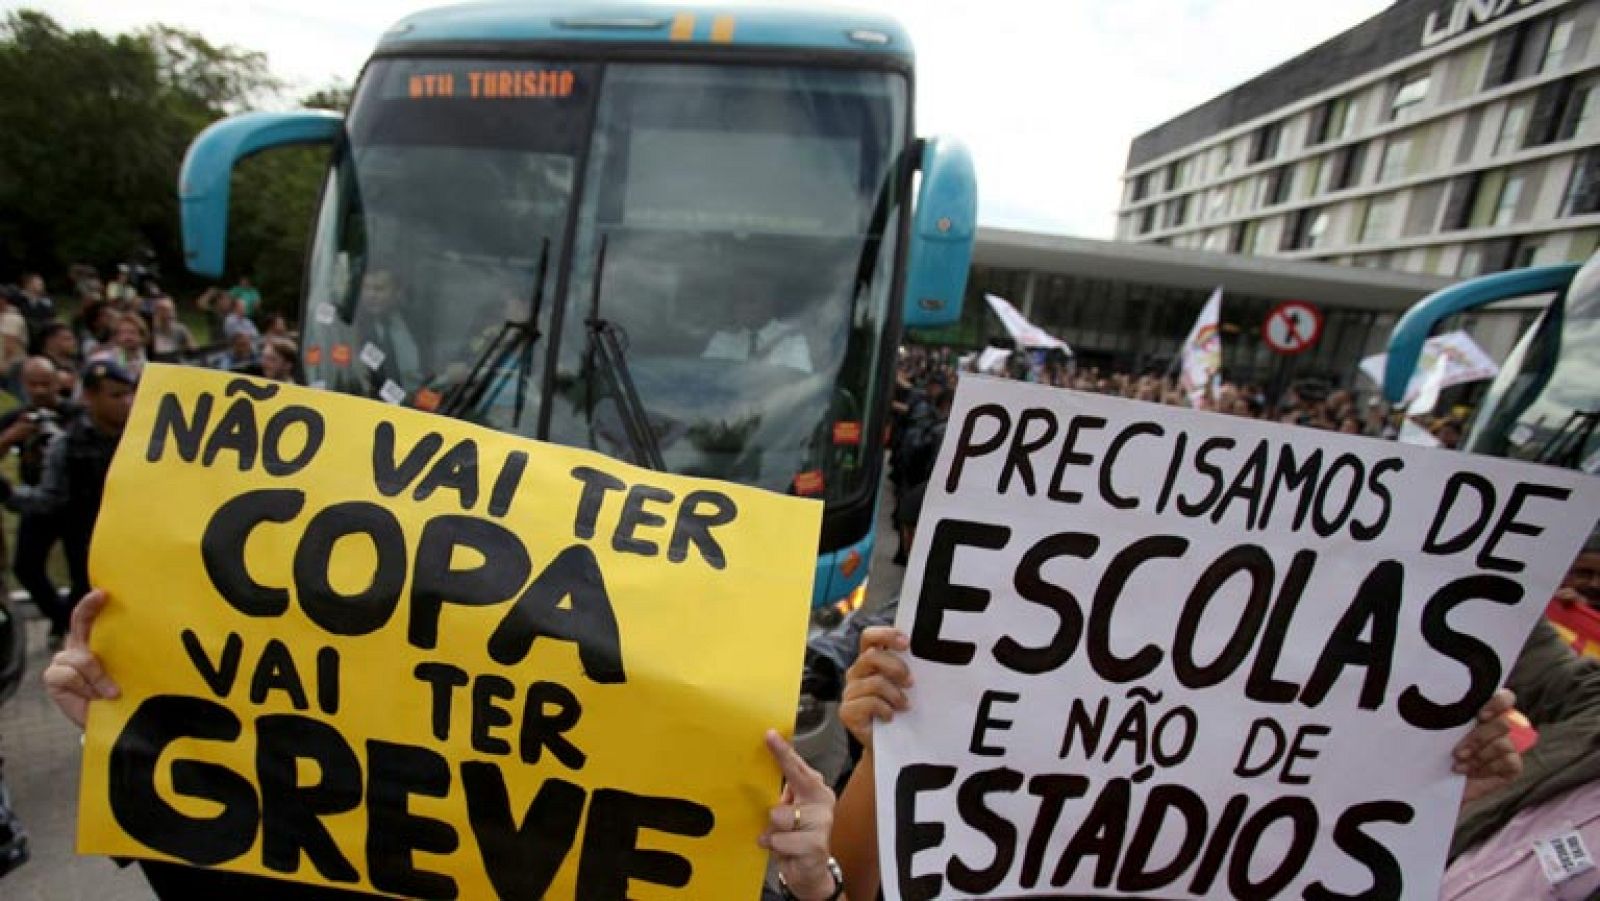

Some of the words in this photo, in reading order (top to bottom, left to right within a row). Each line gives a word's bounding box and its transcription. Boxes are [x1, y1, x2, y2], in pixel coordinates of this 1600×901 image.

[467, 69, 575, 98] TURISMO
[144, 379, 326, 477] NÃO
[372, 421, 529, 518] VAI
[571, 466, 738, 570] TER
[945, 403, 1405, 542] PRECISAMOS
[1421, 470, 1573, 574] DE
[201, 489, 628, 685] COPA
[909, 518, 1526, 731] ESCOLAS
[180, 629, 341, 716] VAI
[413, 661, 588, 771] TER
[968, 690, 1020, 758] E
[1058, 685, 1199, 769] NÃO
[1232, 716, 1332, 786] DE
[108, 693, 716, 901] GREVE
[895, 762, 1416, 901] ESTÁDIOS
